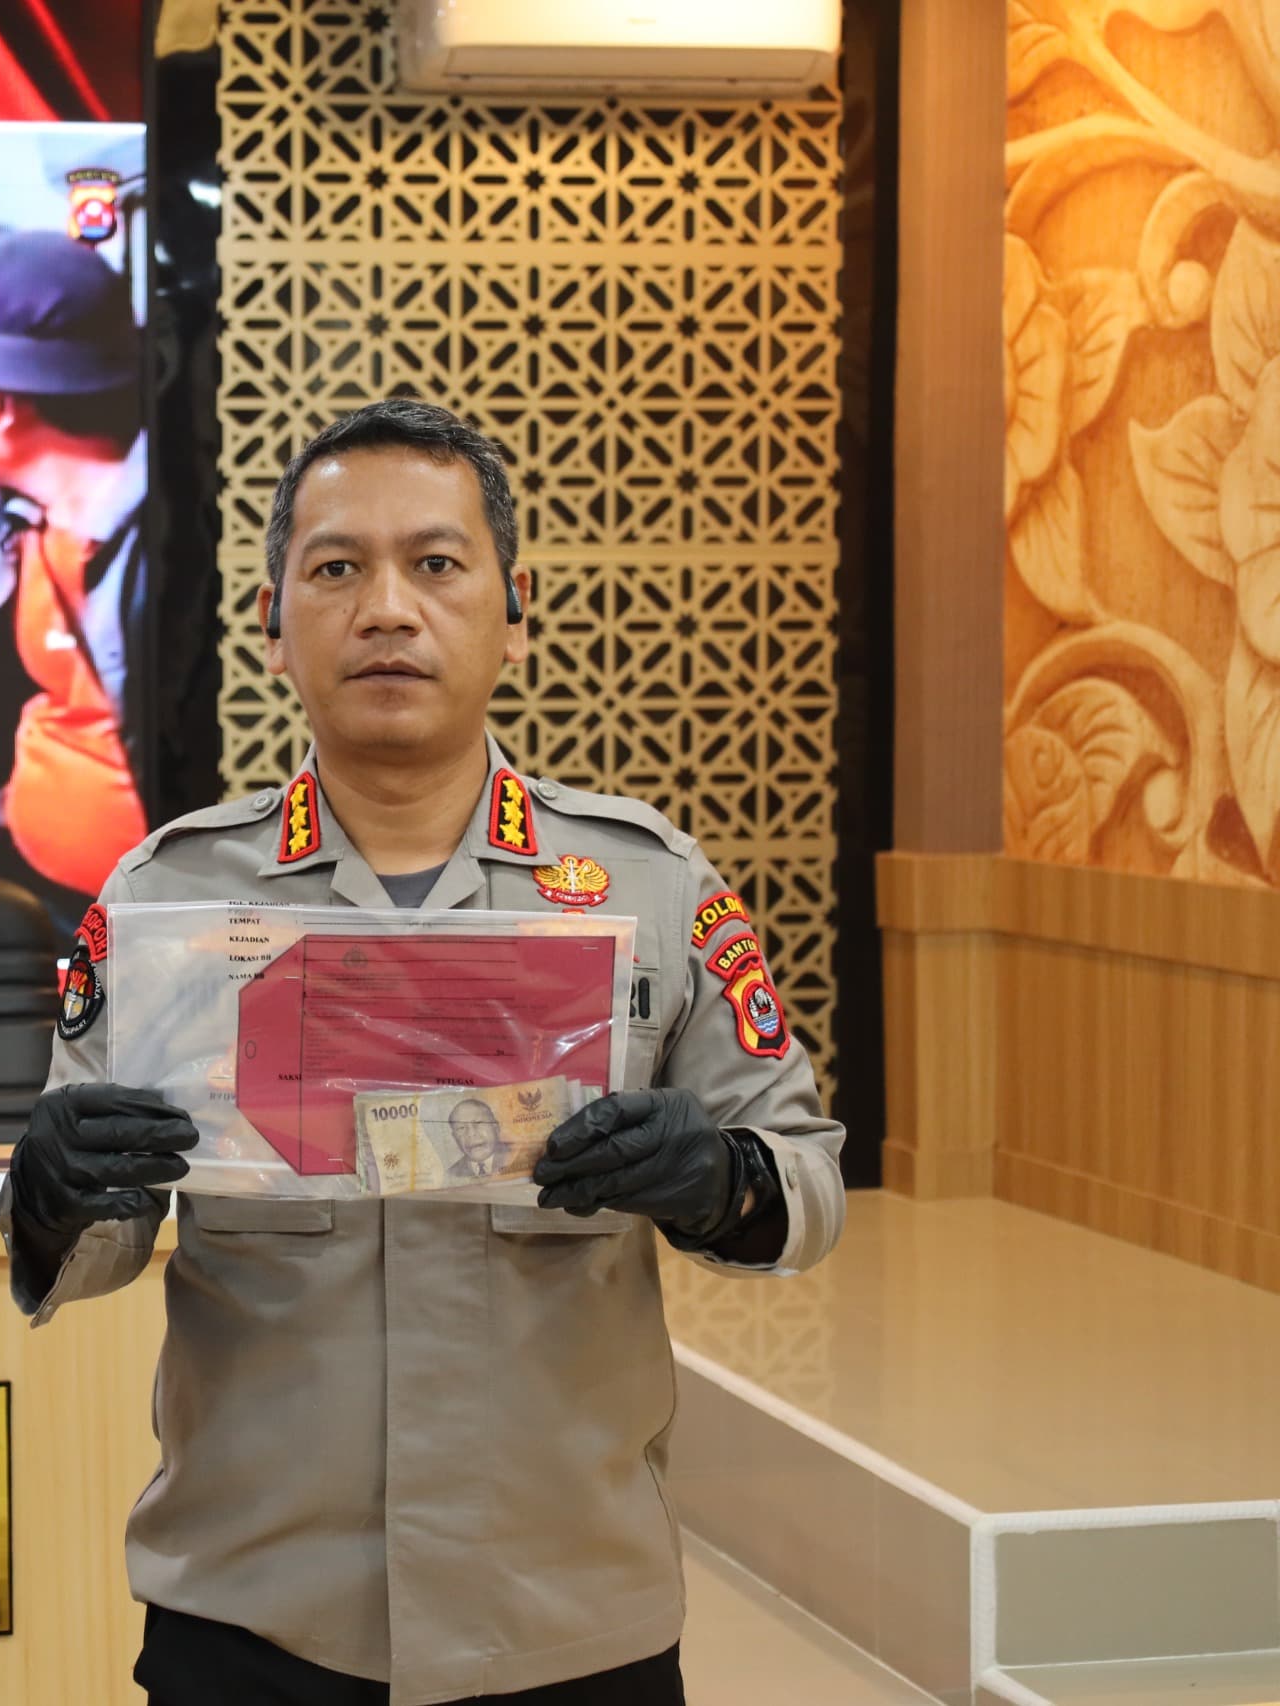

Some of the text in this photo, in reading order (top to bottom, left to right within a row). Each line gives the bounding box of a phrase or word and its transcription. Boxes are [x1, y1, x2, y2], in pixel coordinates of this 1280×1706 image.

[692, 896, 745, 940] POLDA
[228, 936, 270, 944] KEJADIAN
[228, 954, 259, 962] LOKASI
[717, 938, 759, 970] BANTEN
[370, 1103, 418, 1121] 10000
